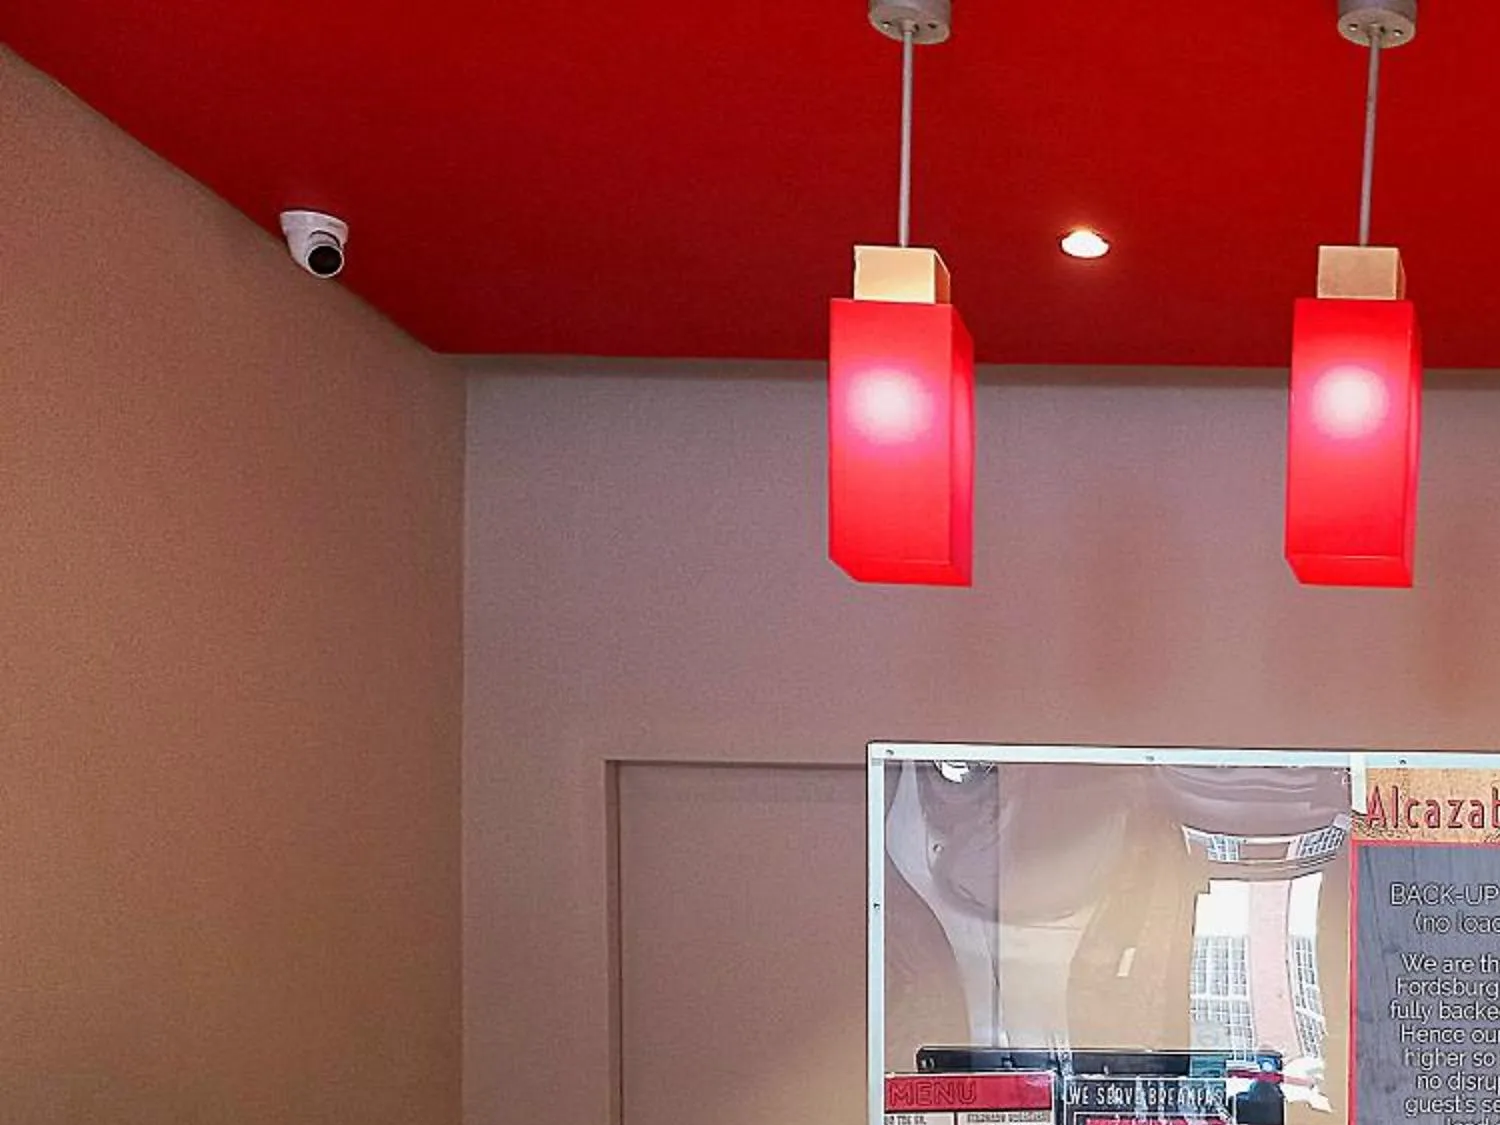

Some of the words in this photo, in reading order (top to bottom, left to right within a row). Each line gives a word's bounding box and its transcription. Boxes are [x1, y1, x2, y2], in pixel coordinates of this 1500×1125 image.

[1390, 883, 1500, 906] BACK-UP
[1414, 912, 1450, 935] (no
[1401, 954, 1438, 974] We
[1443, 958, 1475, 973] are
[1396, 977, 1500, 1001] Fordsburg
[1390, 1002, 1433, 1024] fully
[1400, 1025, 1466, 1044] Hence
[1404, 1048, 1466, 1071] higher
[1471, 1052, 1497, 1067] so
[1416, 1074, 1442, 1090] no
[889, 1081, 977, 1106] MENU
[1069, 1085, 1089, 1104] WE
